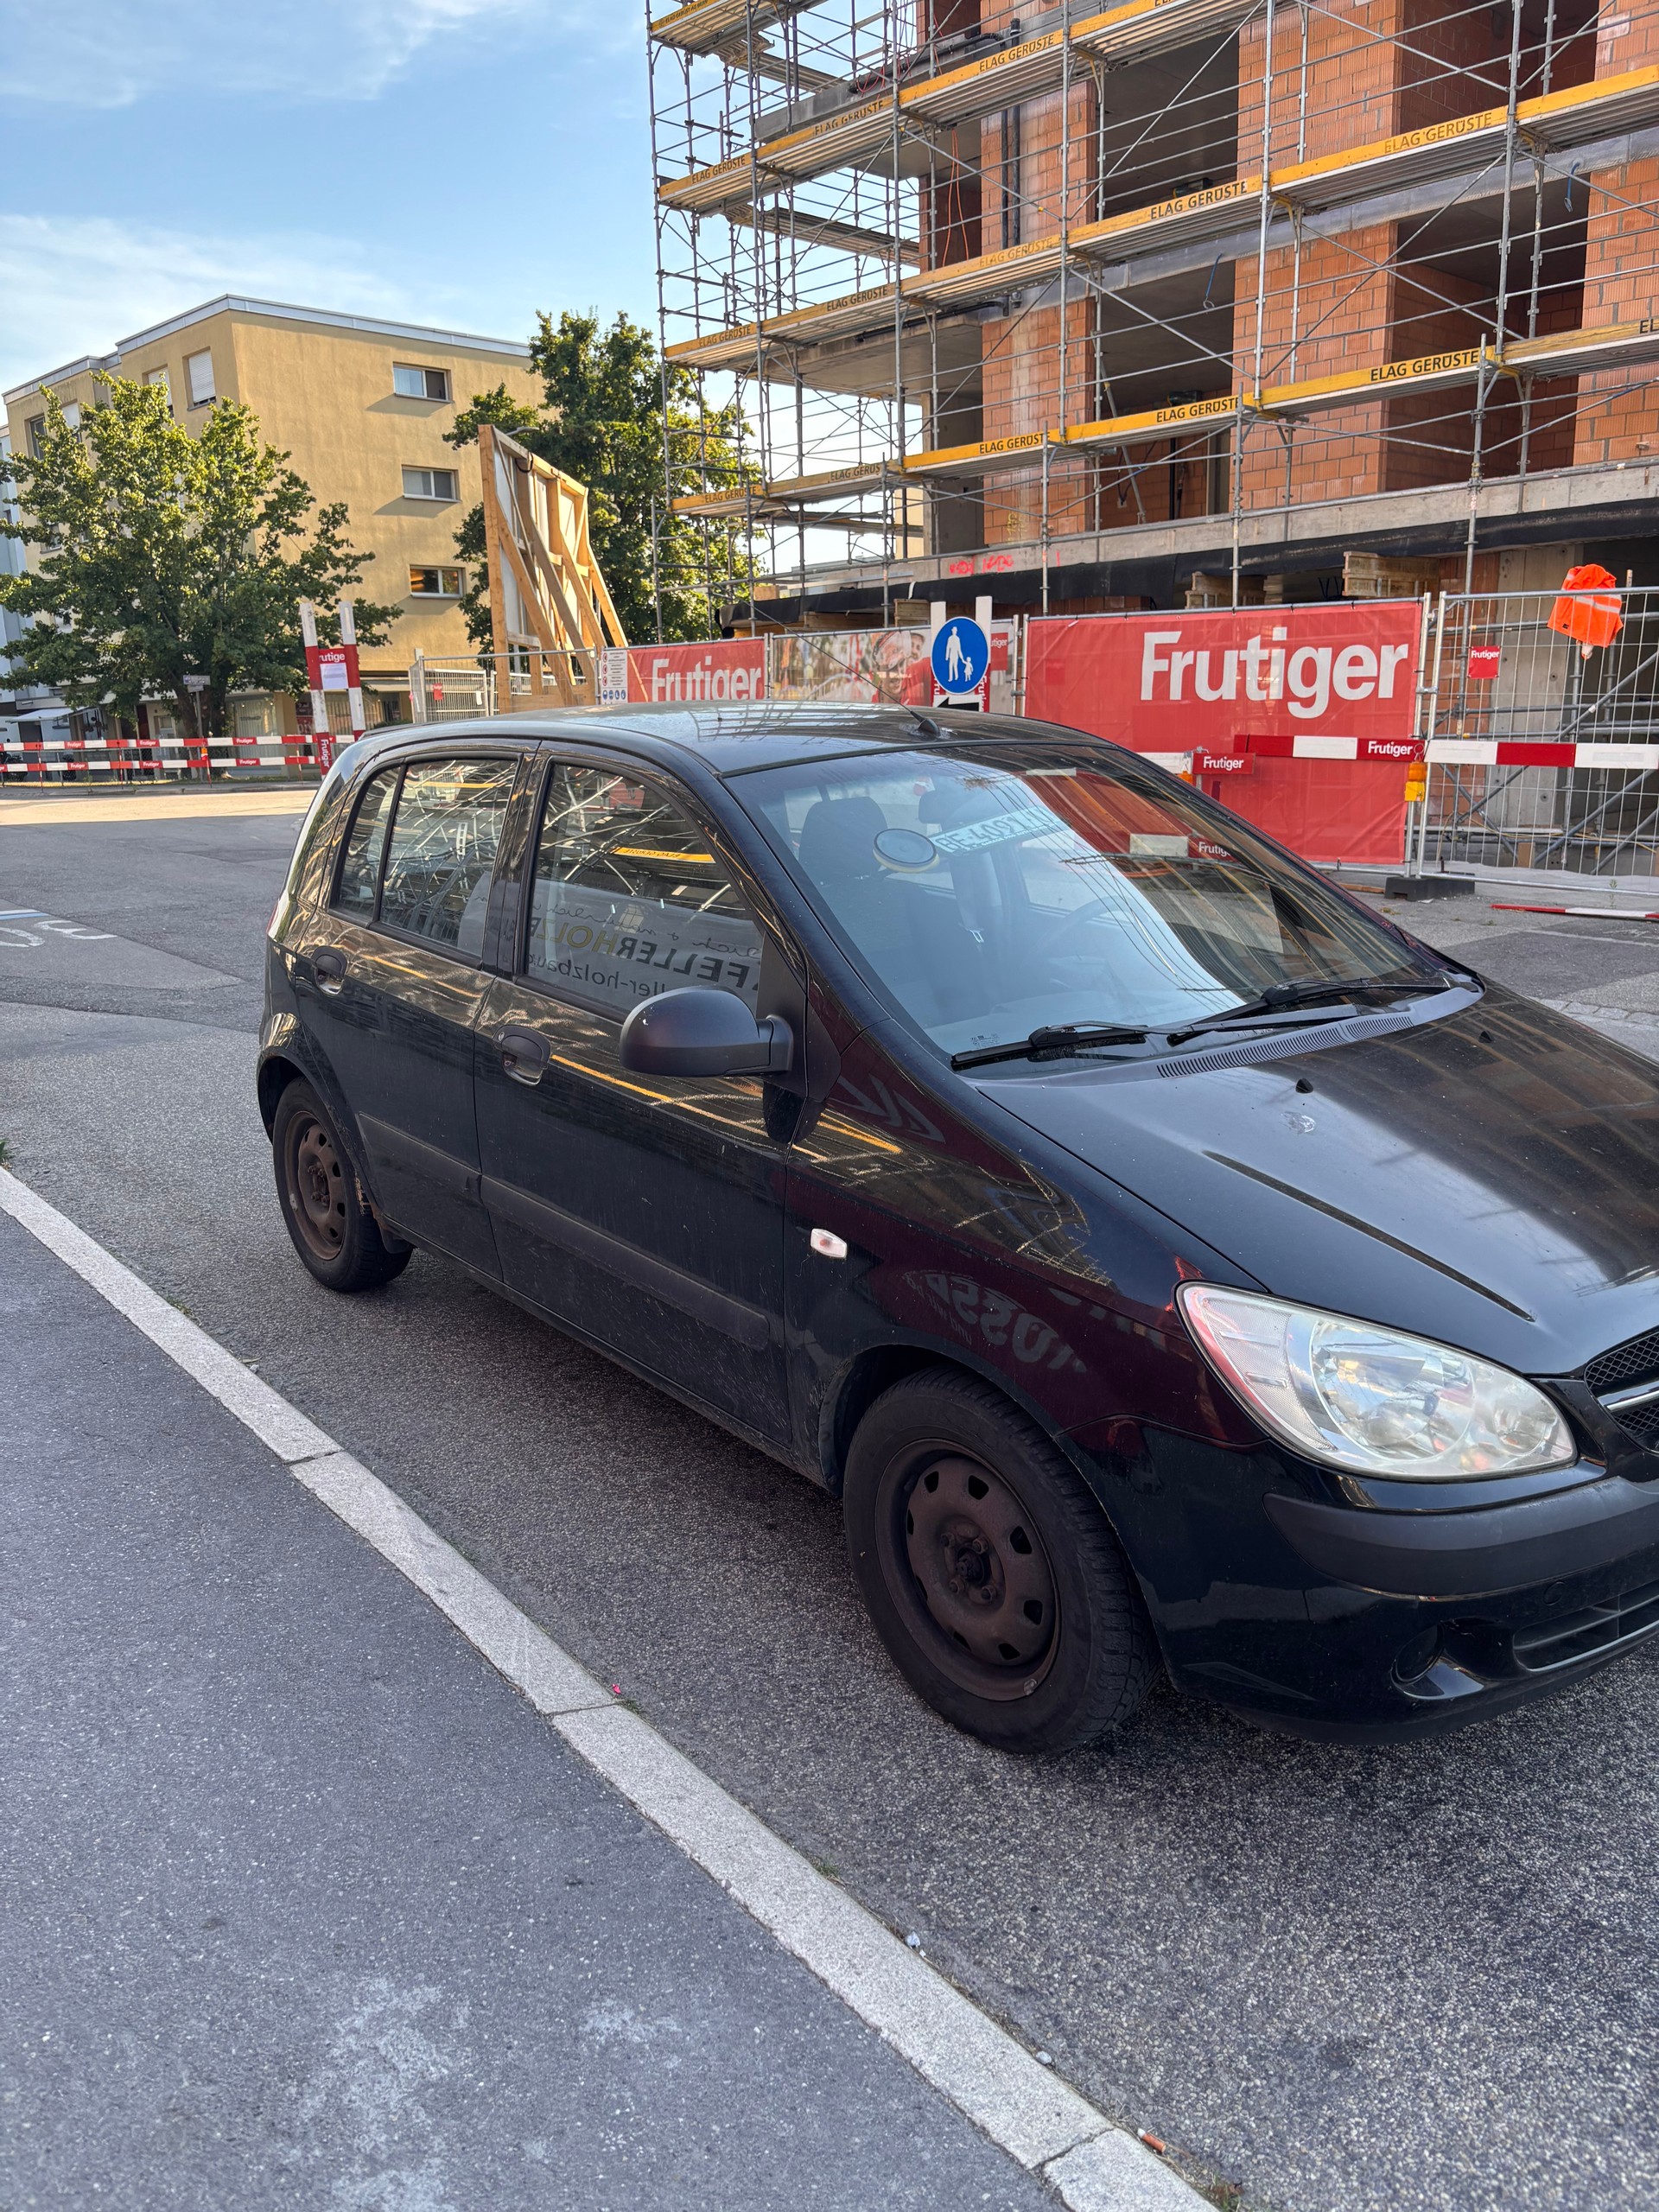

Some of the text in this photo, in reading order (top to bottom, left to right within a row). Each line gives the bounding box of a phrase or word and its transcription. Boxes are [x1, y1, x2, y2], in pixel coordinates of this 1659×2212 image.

[979, 34, 1054, 73] ELAG GERÜSTE
[1384, 112, 1492, 154] ELAG GERÜSTE
[692, 169, 710, 184] ELAG
[1151, 181, 1248, 219] ELAG GERÜSTE
[979, 251, 1005, 268] ELAG
[827, 298, 849, 312] ELAG
[699, 335, 717, 347] ELAG
[1370, 350, 1479, 381] ELAG GERÜSTE
[1156, 407, 1185, 423] ELAG
[979, 441, 1004, 454] ELAG
[830, 470, 852, 481] ELAG
[704, 490, 723, 504] ELAG
[1471, 649, 1500, 660] Frutiger
[652, 655, 762, 702] Frutiger
[1141, 626, 1409, 719] Frutiger
[321, 739, 330, 767] Frutiger
[1368, 741, 1414, 758] Frutiger
[1203, 756, 1244, 772] Frutiger
